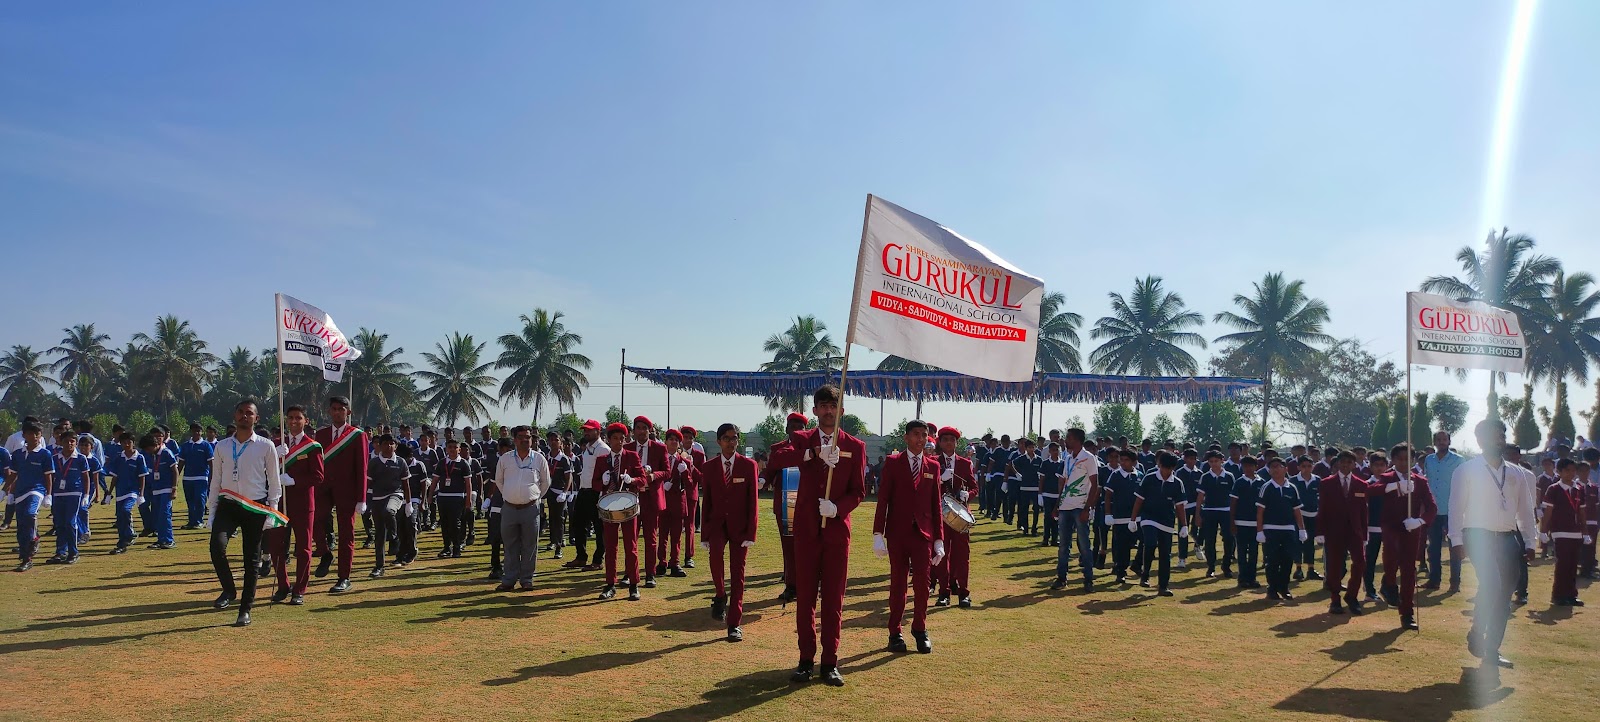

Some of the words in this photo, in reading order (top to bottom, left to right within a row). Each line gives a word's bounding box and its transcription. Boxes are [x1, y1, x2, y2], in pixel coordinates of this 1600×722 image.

[881, 243, 1023, 309] GURUKUL
[905, 244, 930, 259] SHREE
[930, 254, 1003, 277] SWAMINARAYAN
[877, 295, 903, 312] VIDYA
[907, 304, 949, 327] SADVIDYA
[952, 320, 1020, 339] BRAHMAVIDYA
[882, 280, 965, 316] INTERNATIONAL
[966, 308, 1018, 325] SCHOOL
[1418, 307, 1519, 337] GURUKUL
[1419, 341, 1485, 354] YAJURVEDA
[1488, 346, 1520, 357] HOUSE
[1421, 332, 1486, 343] INTERNATIONAL
[1488, 337, 1519, 346] SCHOOL
